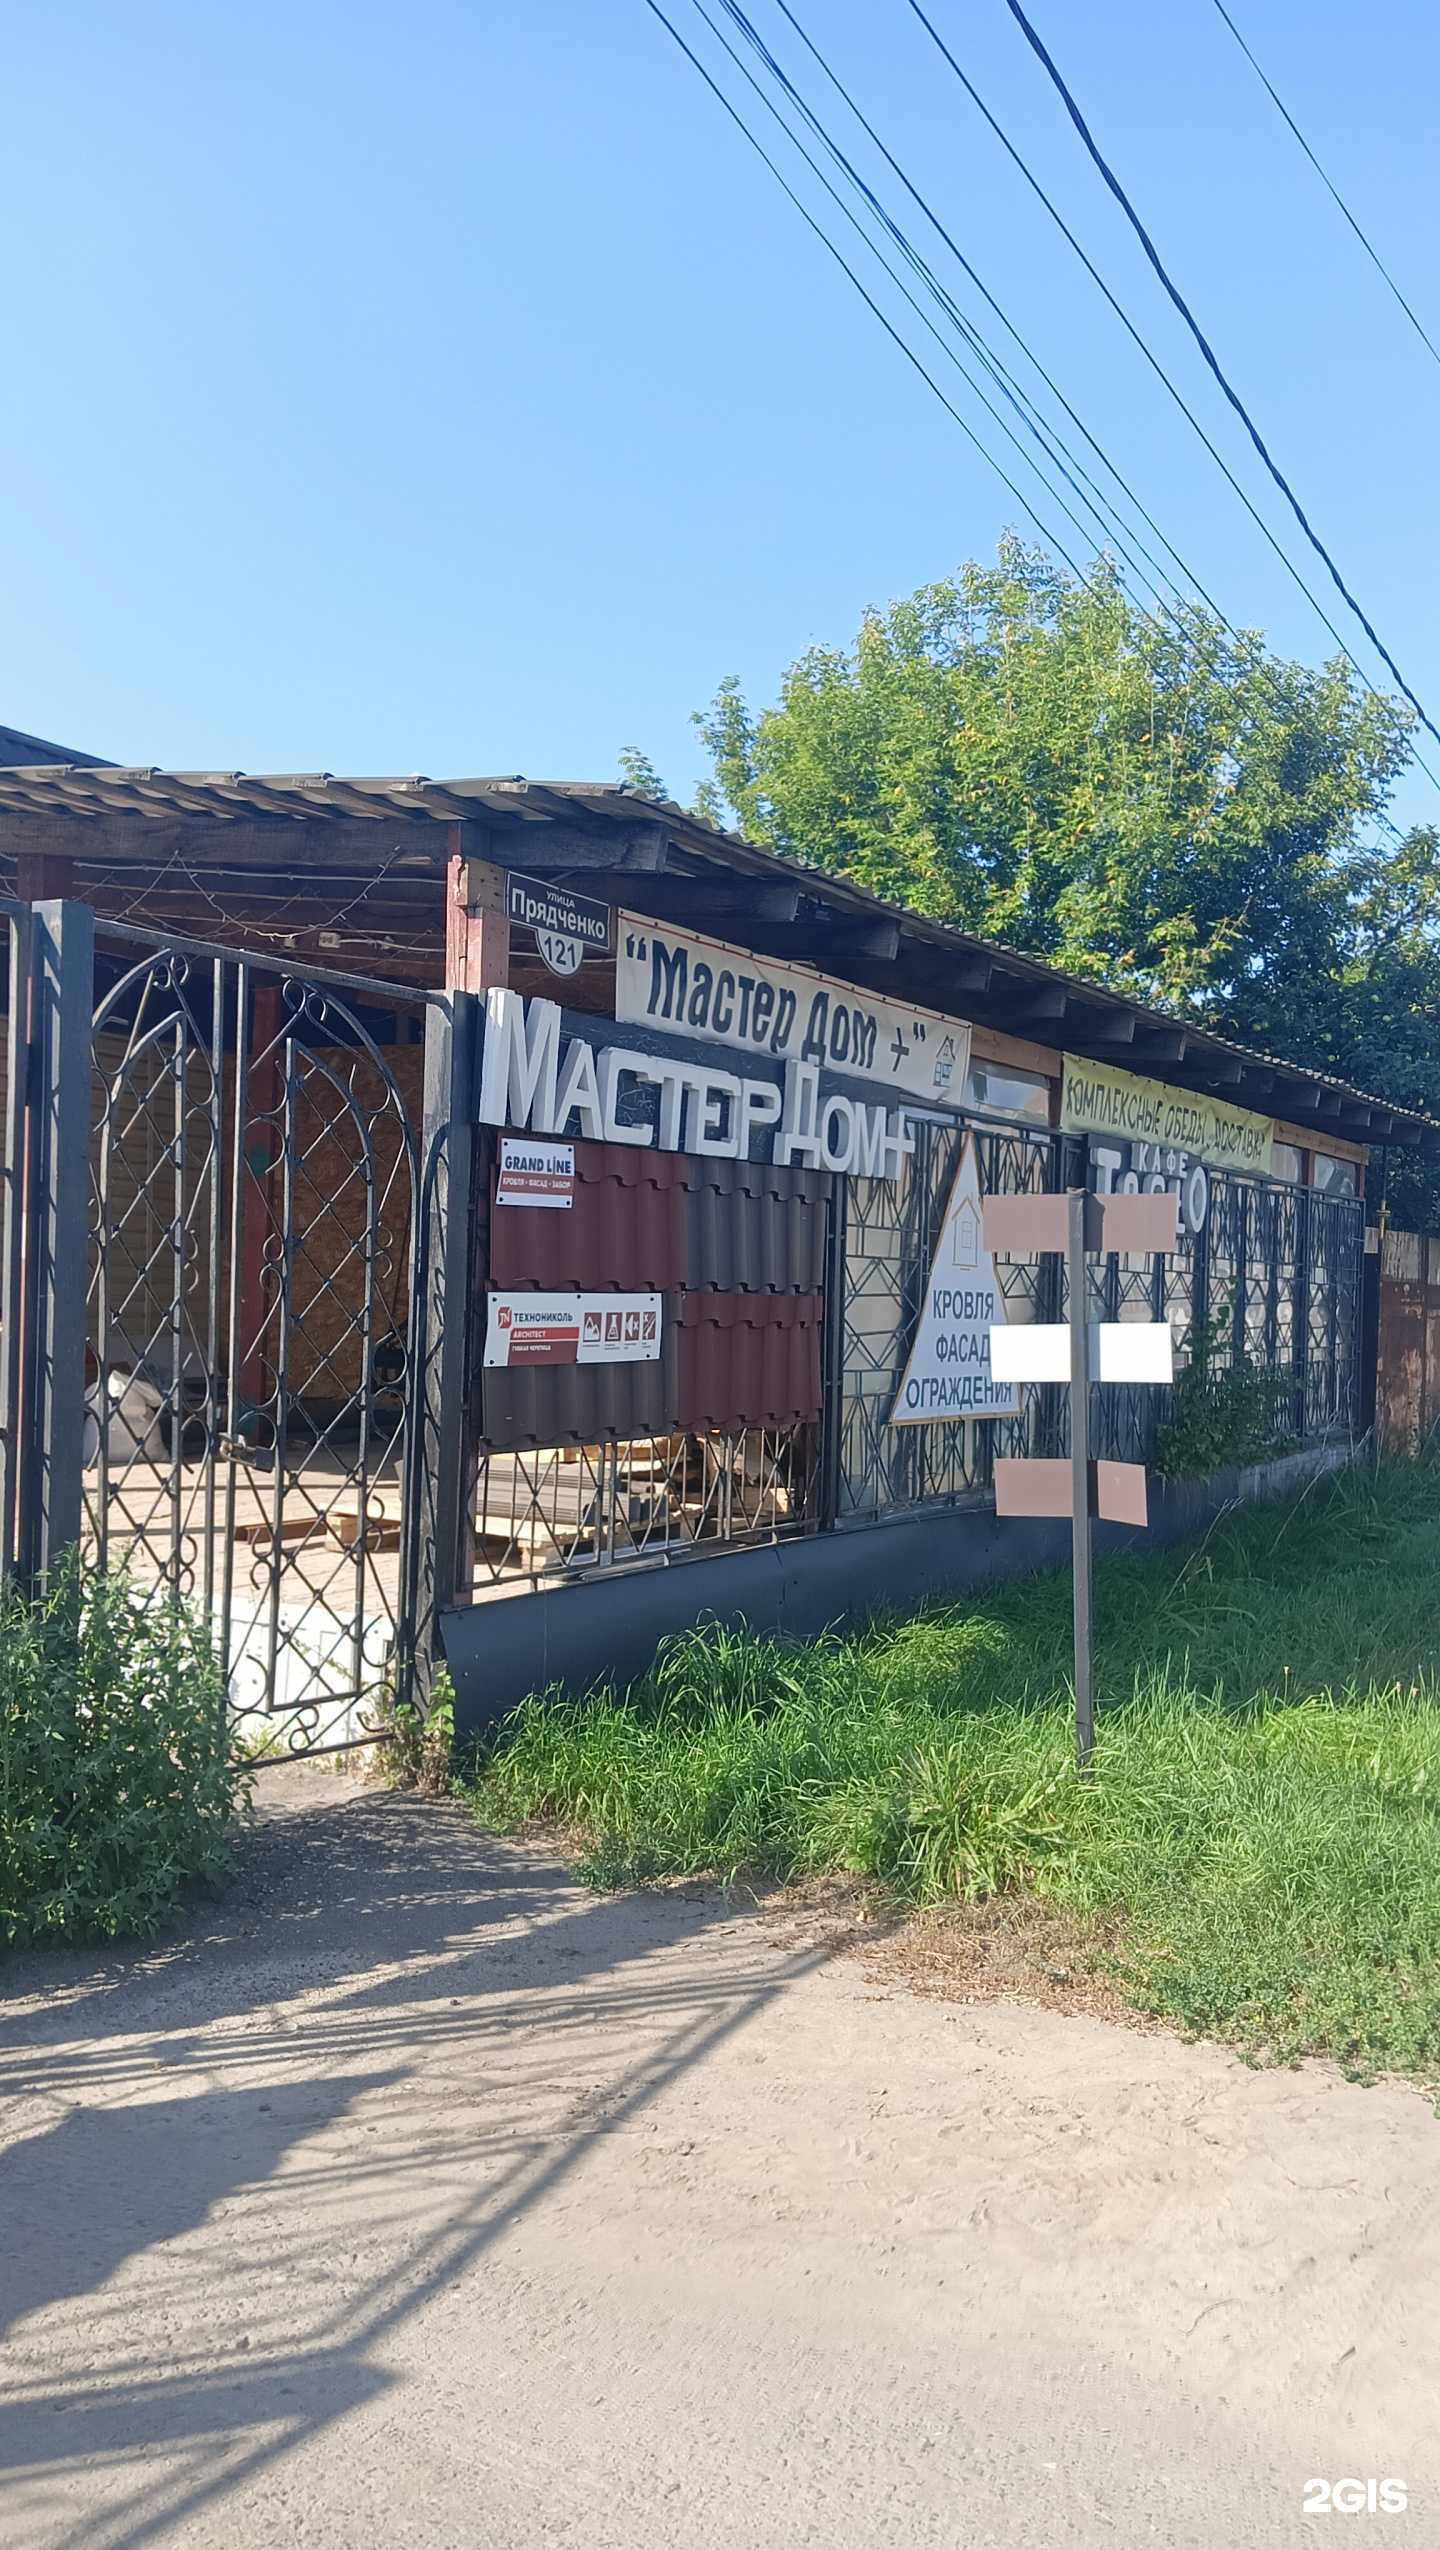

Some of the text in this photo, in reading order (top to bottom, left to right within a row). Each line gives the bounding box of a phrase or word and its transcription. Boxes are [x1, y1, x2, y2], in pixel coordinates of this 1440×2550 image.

[512, 887, 605, 939] Прядченко
[546, 890, 576, 908] УЛИЦА
[544, 935, 576, 968] 121
[801, 991, 878, 1070] Дом
[1065, 1076, 1164, 1135] КОМПЛЕКСНЫЕ
[505, 1155, 545, 1173] GRAND
[1137, 1142, 1188, 1178] КАФЕ
[514, 1312, 573, 1322] ТЕХНОНИКОЛЬ
[933, 1290, 994, 1320] КРОВЛЯ
[936, 1333, 991, 1367] ФАСАД
[906, 1376, 1012, 1410] ОГРАЖДЕНИЯ
